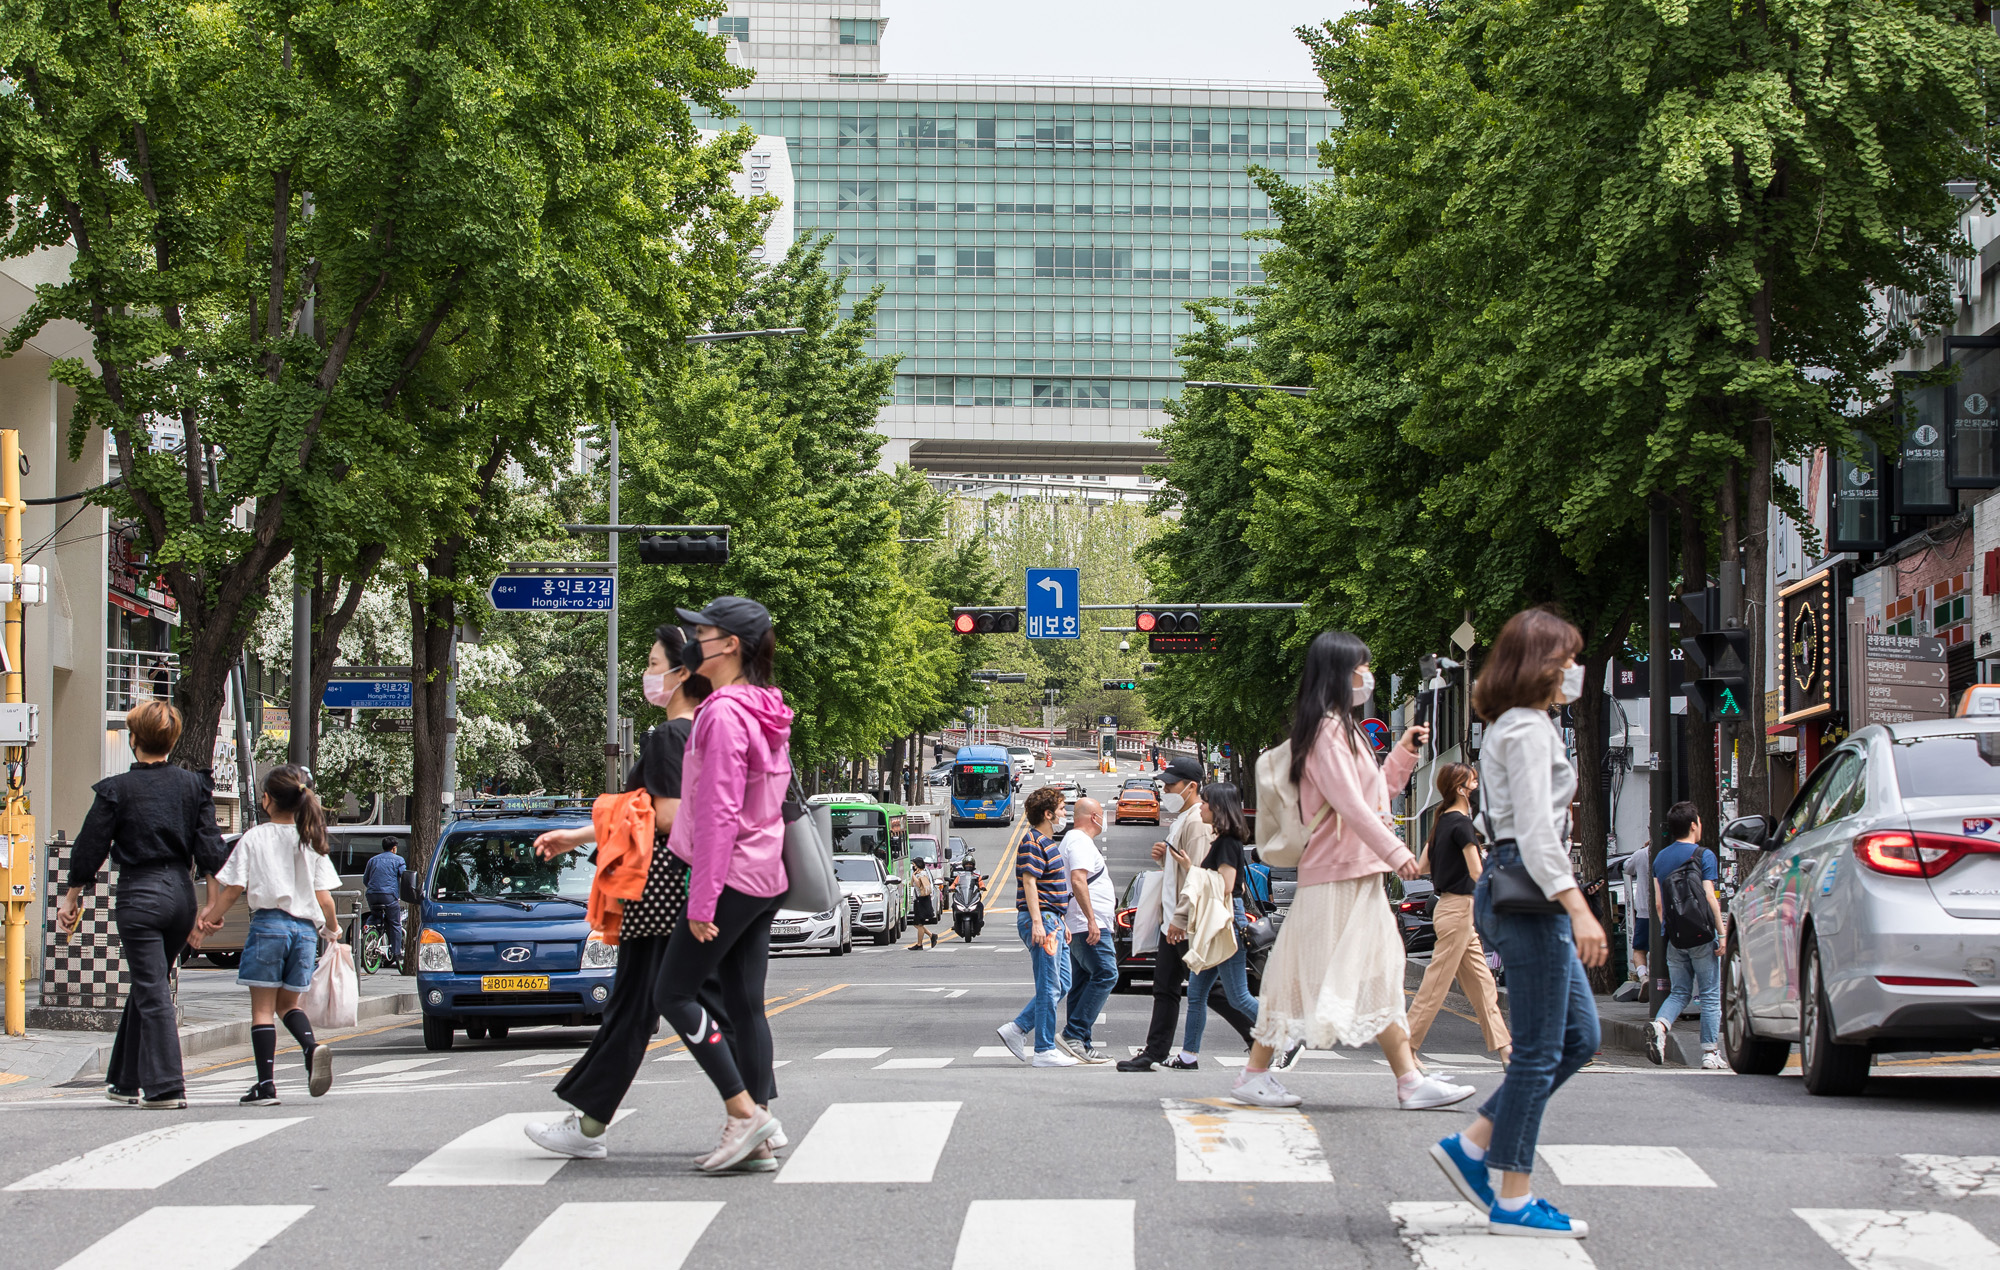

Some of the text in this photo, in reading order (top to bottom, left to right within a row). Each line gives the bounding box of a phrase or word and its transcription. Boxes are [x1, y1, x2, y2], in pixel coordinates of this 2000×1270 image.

[541, 579, 611, 596] 홍익로2길
[531, 597, 610, 609] Hongik-ro 2-gil
[1029, 615, 1076, 637] 비보호
[1897, 636, 1920, 648] 홍대센터
[373, 683, 410, 693] 홍익로2길
[1868, 687, 1891, 697] 상상마당
[1964, 820, 1985, 832] 개인
[516, 978, 544, 989] 4667
